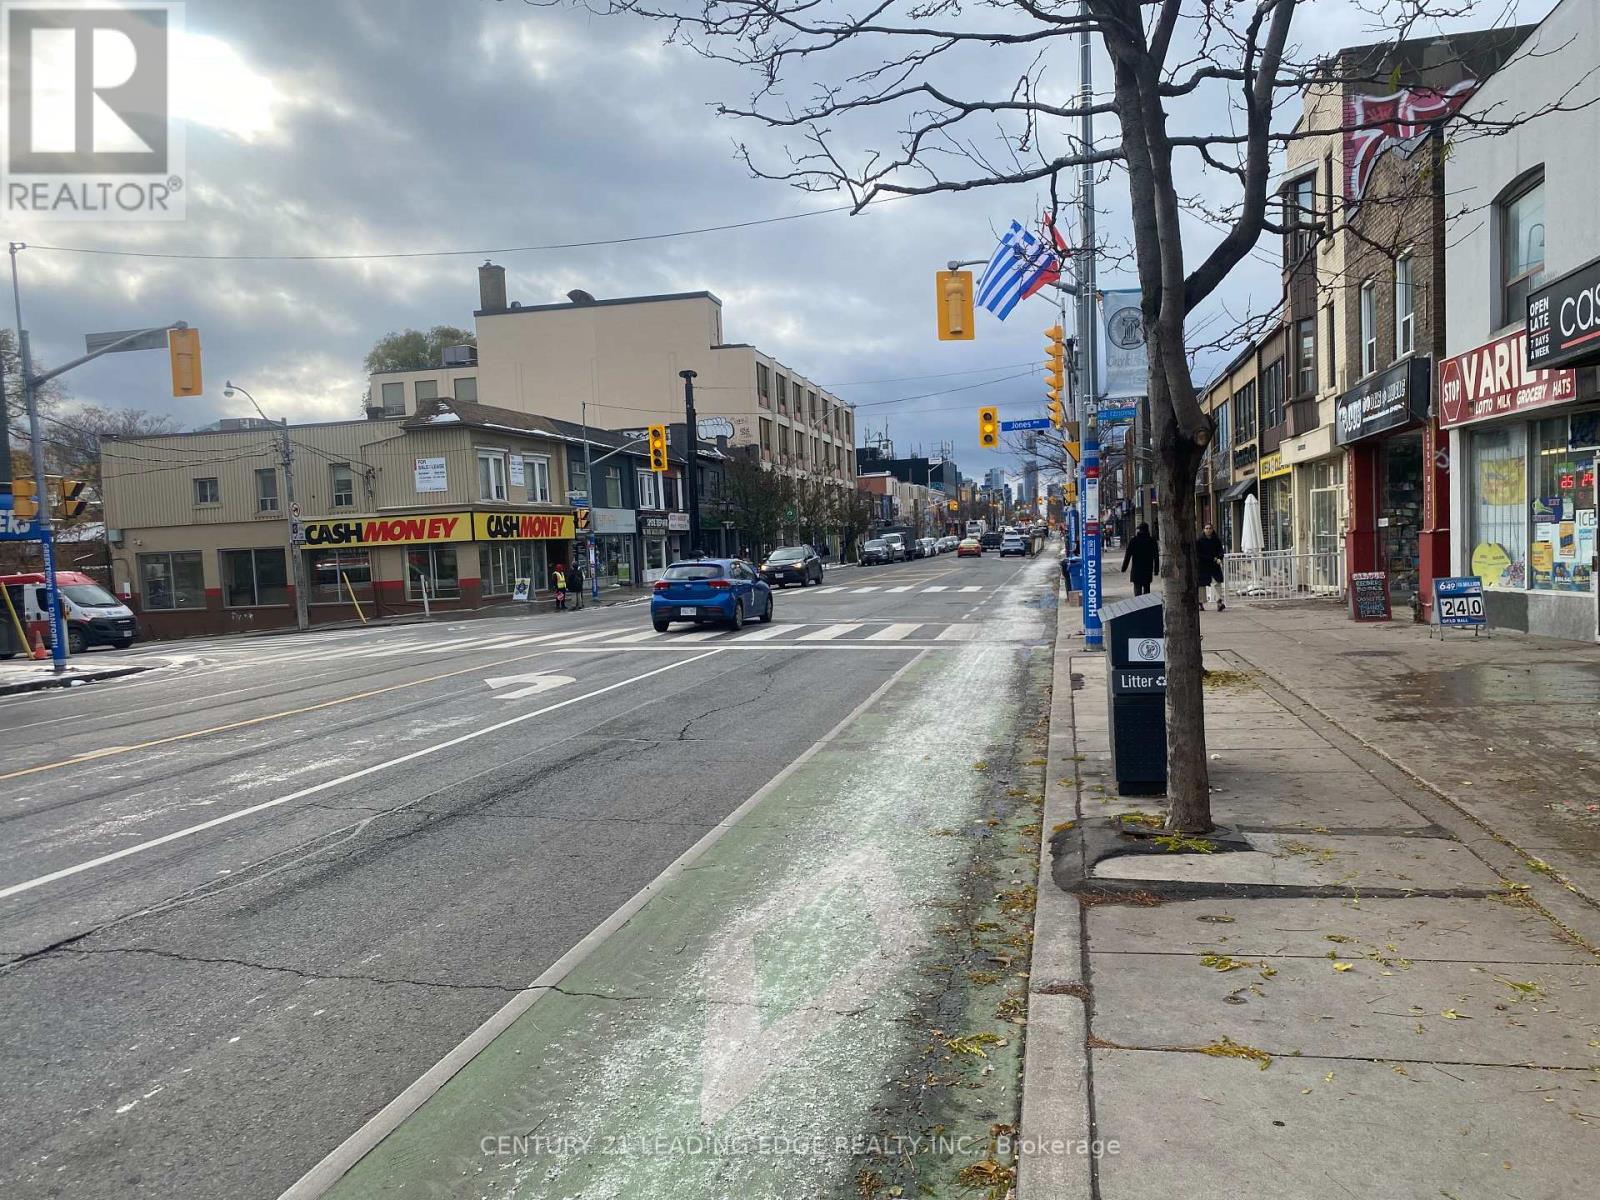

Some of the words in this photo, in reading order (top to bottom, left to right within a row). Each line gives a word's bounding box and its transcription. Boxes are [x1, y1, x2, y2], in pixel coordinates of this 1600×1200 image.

[1529, 296, 1549, 317] OPEN
[1529, 312, 1549, 333] LATE
[1530, 339, 1534, 349] 7
[1535, 333, 1550, 347] DAYS
[1530, 350, 1535, 360] A
[1535, 344, 1550, 358] WEEK
[1444, 379, 1460, 403] STOP
[1475, 397, 1493, 415] LOTTO
[1496, 393, 1511, 409] MILK
[1516, 383, 1547, 406] GROCERY
[1011, 422, 1032, 430] Jones
[1578, 511, 1596, 527] ICE
[1087, 560, 1097, 618] DANFORTH
[48, 607, 59, 649] DANFORTH
[1121, 674, 1153, 688] Litter
